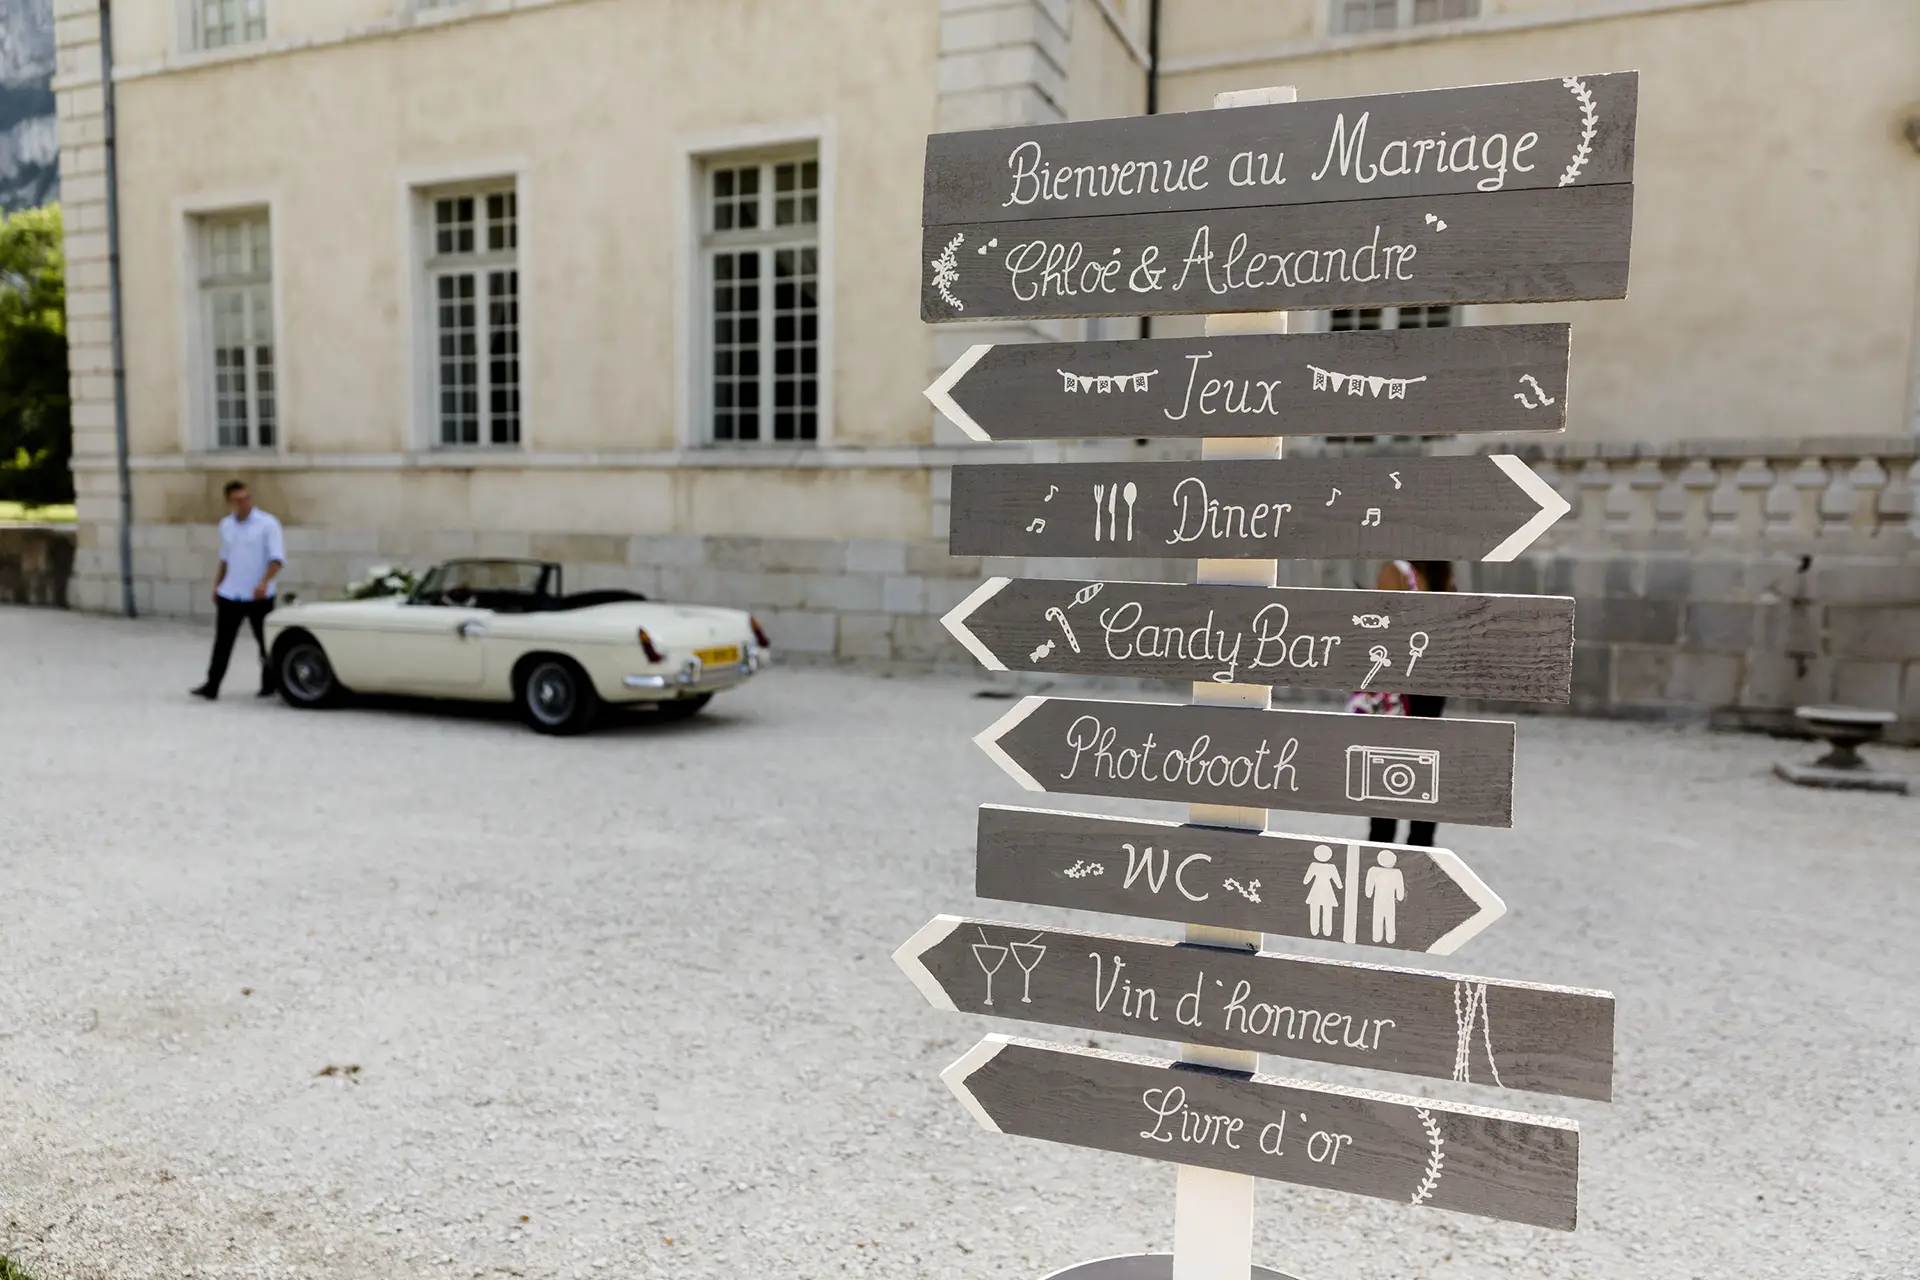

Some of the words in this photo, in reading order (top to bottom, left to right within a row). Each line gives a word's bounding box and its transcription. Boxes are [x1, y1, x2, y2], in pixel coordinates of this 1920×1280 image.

[1002, 141, 1208, 207] Bienvenue
[1229, 151, 1286, 186] au
[1311, 112, 1538, 191] Mariage
[1006, 241, 1121, 300] Chloé
[1129, 246, 1166, 292] &
[1173, 225, 1416, 294] Alexandre
[1164, 351, 1281, 419] Jeux
[1166, 478, 1291, 544] Dîner
[1100, 602, 1242, 683] Candy
[1248, 603, 1341, 668] Bar
[1061, 715, 1298, 791] Photobooth
[1122, 844, 1211, 901] WC
[1089, 953, 1158, 1021] Vin
[1140, 1086, 1243, 1149] Livre
